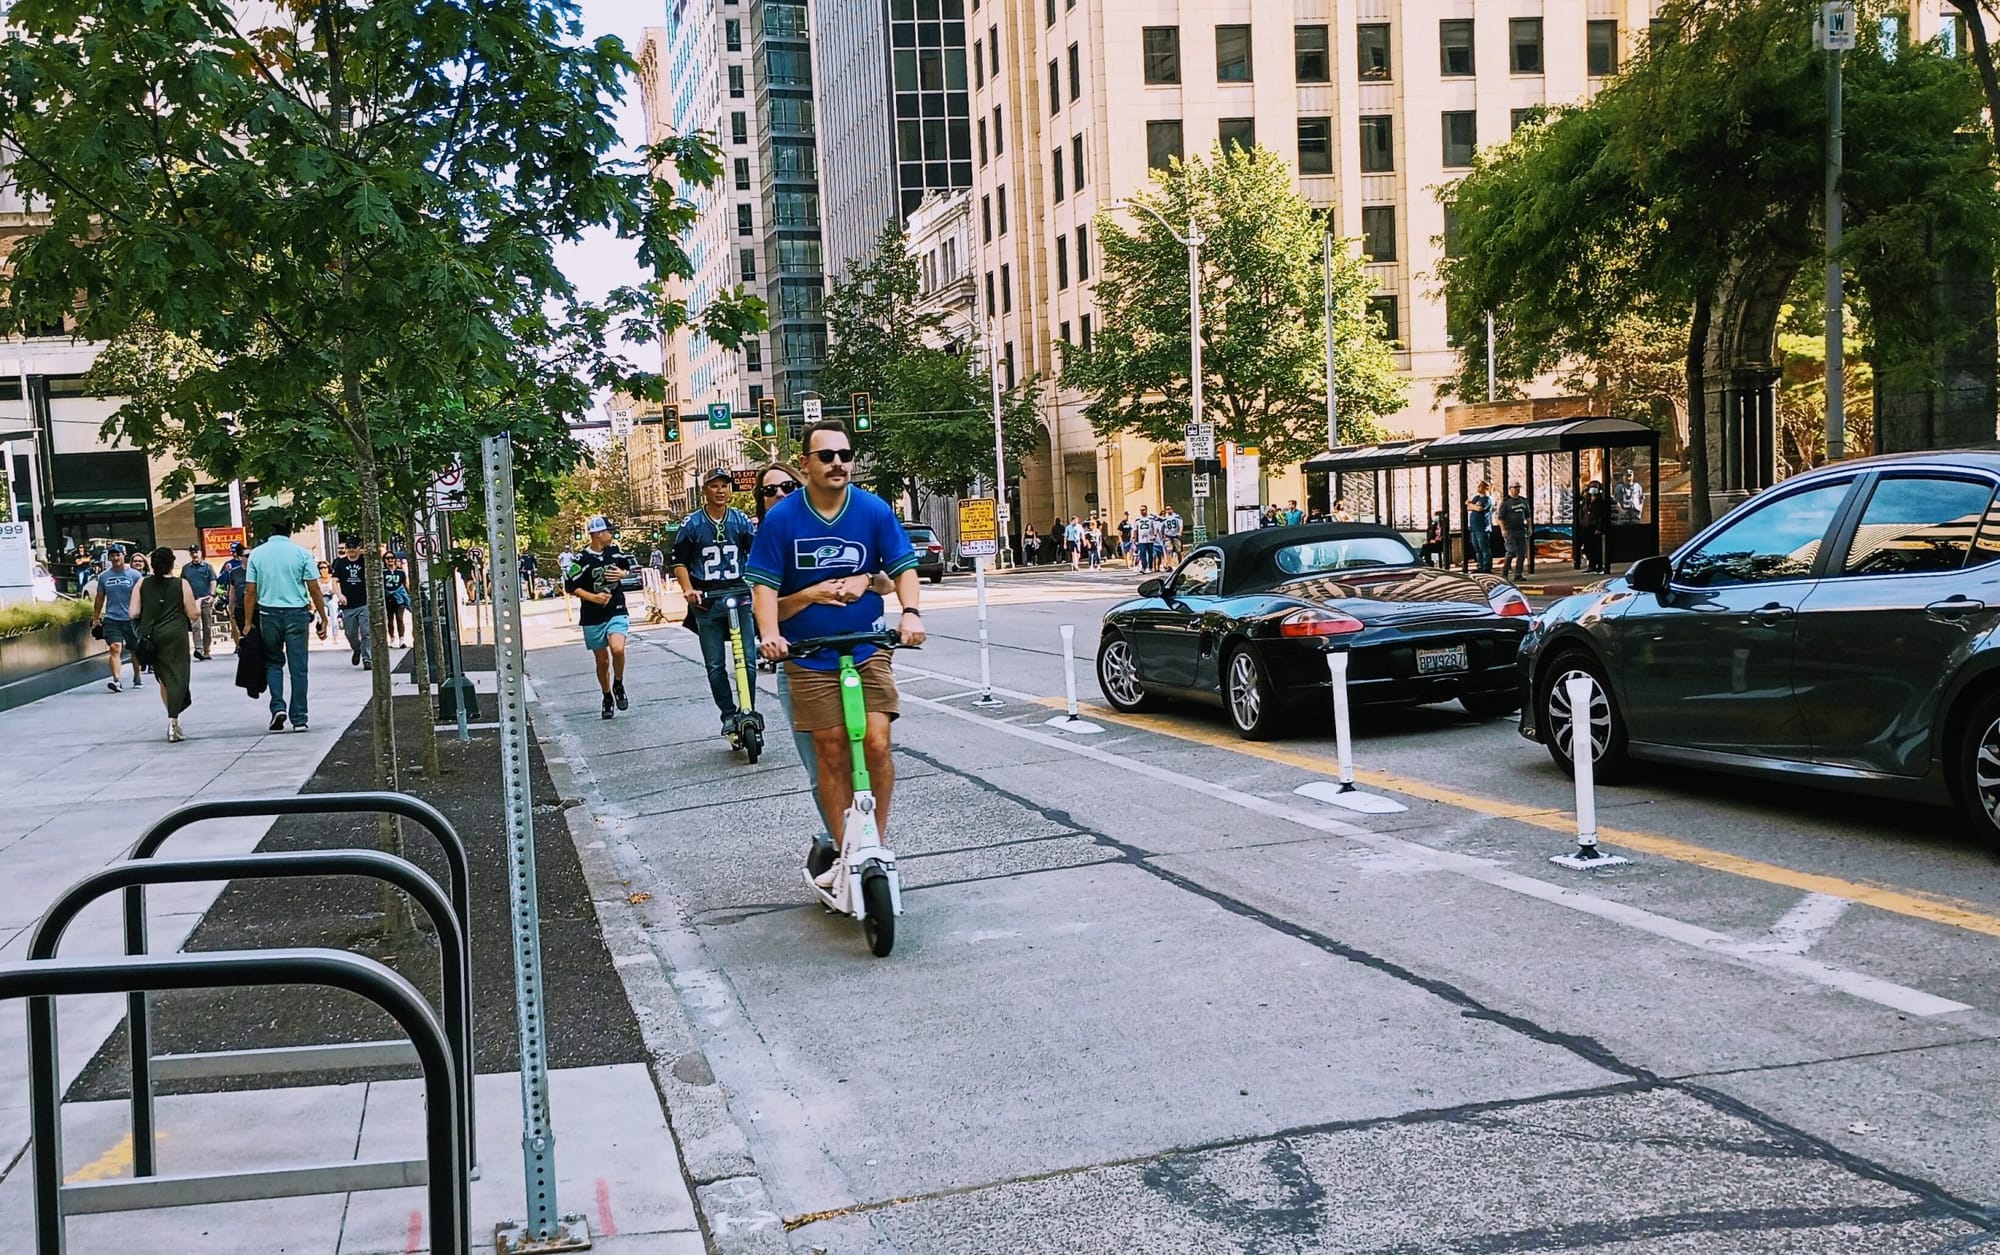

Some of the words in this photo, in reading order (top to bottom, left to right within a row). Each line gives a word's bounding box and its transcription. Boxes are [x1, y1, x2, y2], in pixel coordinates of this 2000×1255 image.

[717, 410, 723, 418] 5
[1140, 520, 1150, 530] 25
[1166, 519, 1177, 530] 89
[207, 534, 242, 543] WELLS
[702, 545, 740, 580] 23
[350, 569, 358, 578] 12
